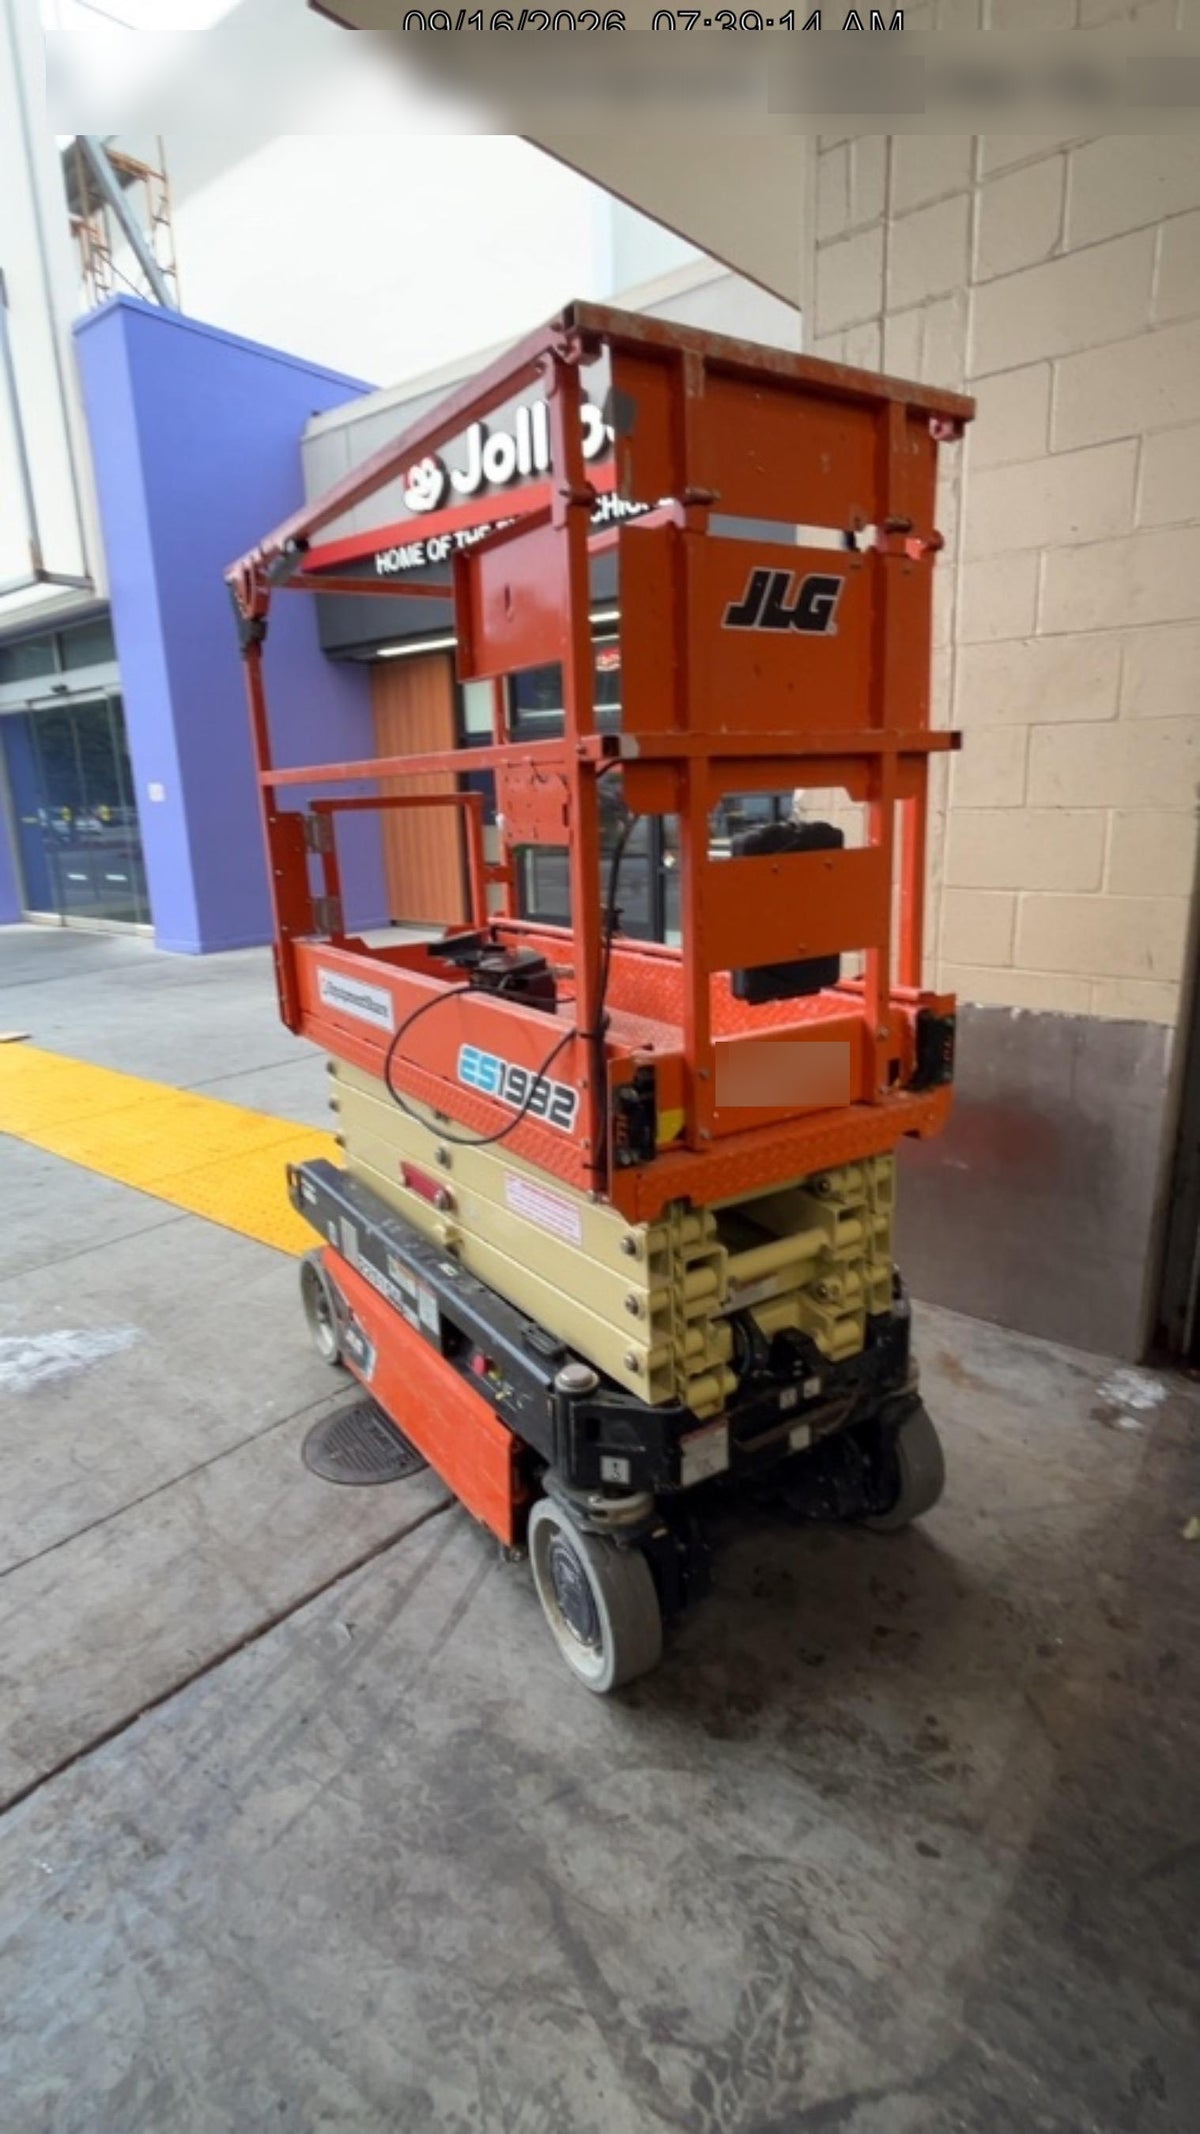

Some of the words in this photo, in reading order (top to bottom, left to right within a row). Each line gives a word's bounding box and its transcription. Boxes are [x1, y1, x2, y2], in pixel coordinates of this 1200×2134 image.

[375, 543, 425, 575] HOME
[426, 538, 451, 562] OF
[722, 567, 844, 635] JLG
